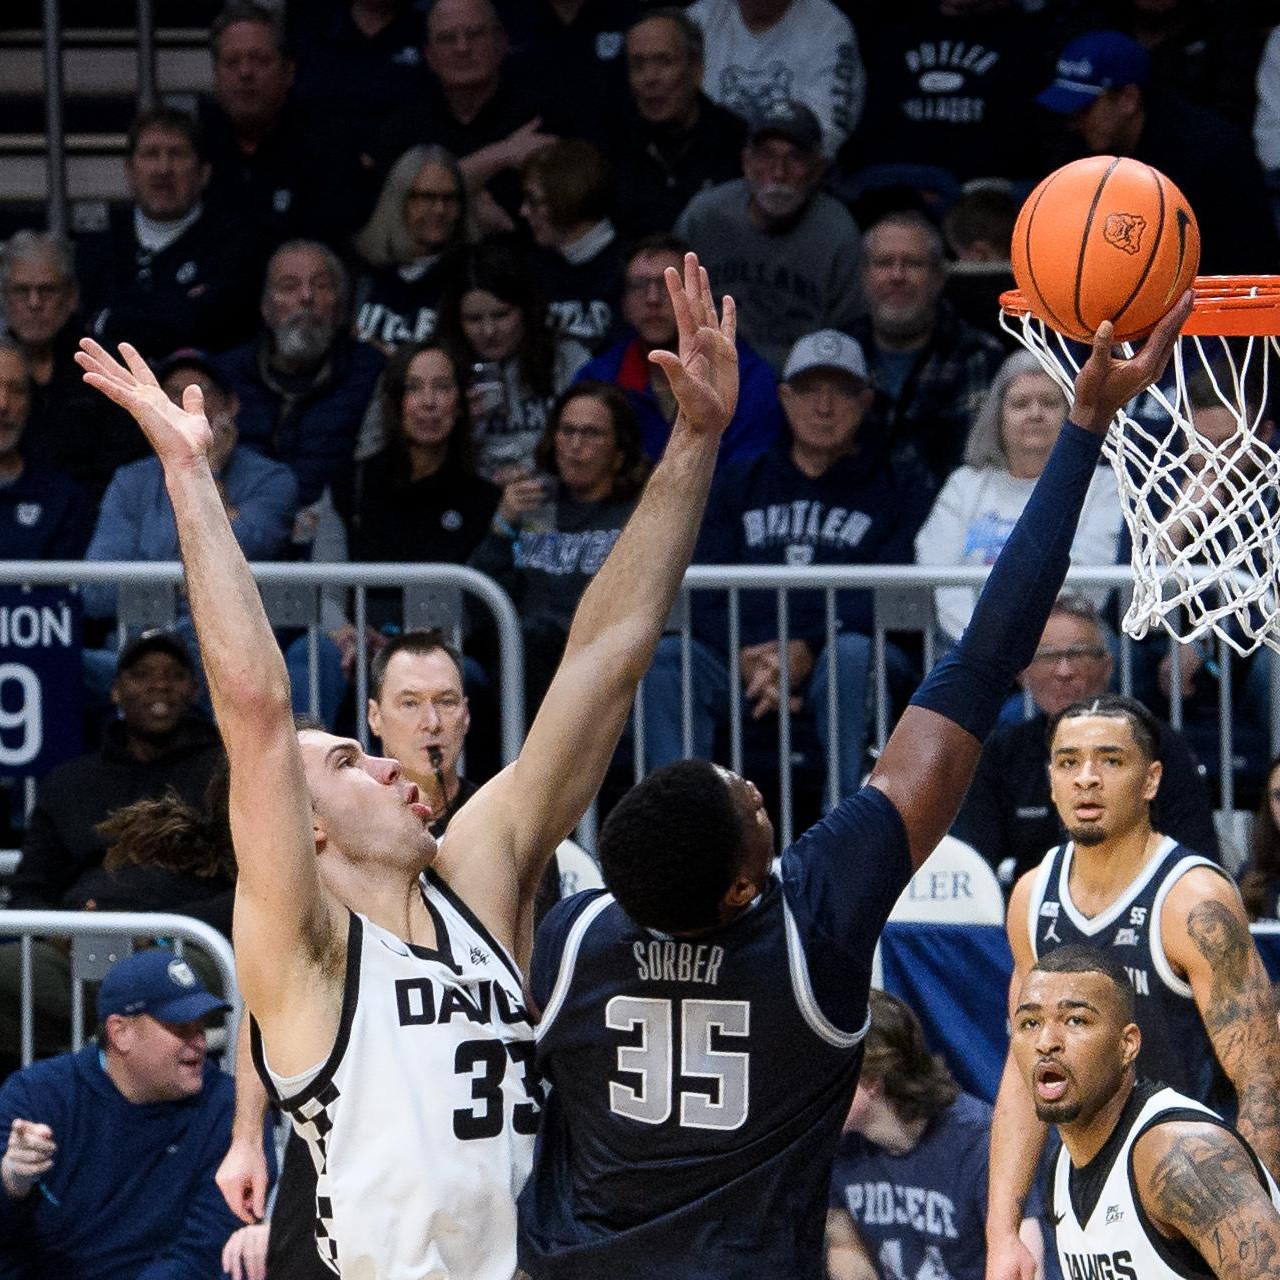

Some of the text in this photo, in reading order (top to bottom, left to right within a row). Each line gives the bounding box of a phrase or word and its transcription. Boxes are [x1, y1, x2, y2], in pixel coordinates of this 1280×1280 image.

[743, 500, 873, 547] BUTLER
[632, 940, 724, 985] SORBER
[394, 977, 539, 1031] DAWG
[453, 1038, 544, 1141] 33
[605, 995, 751, 1131] 35
